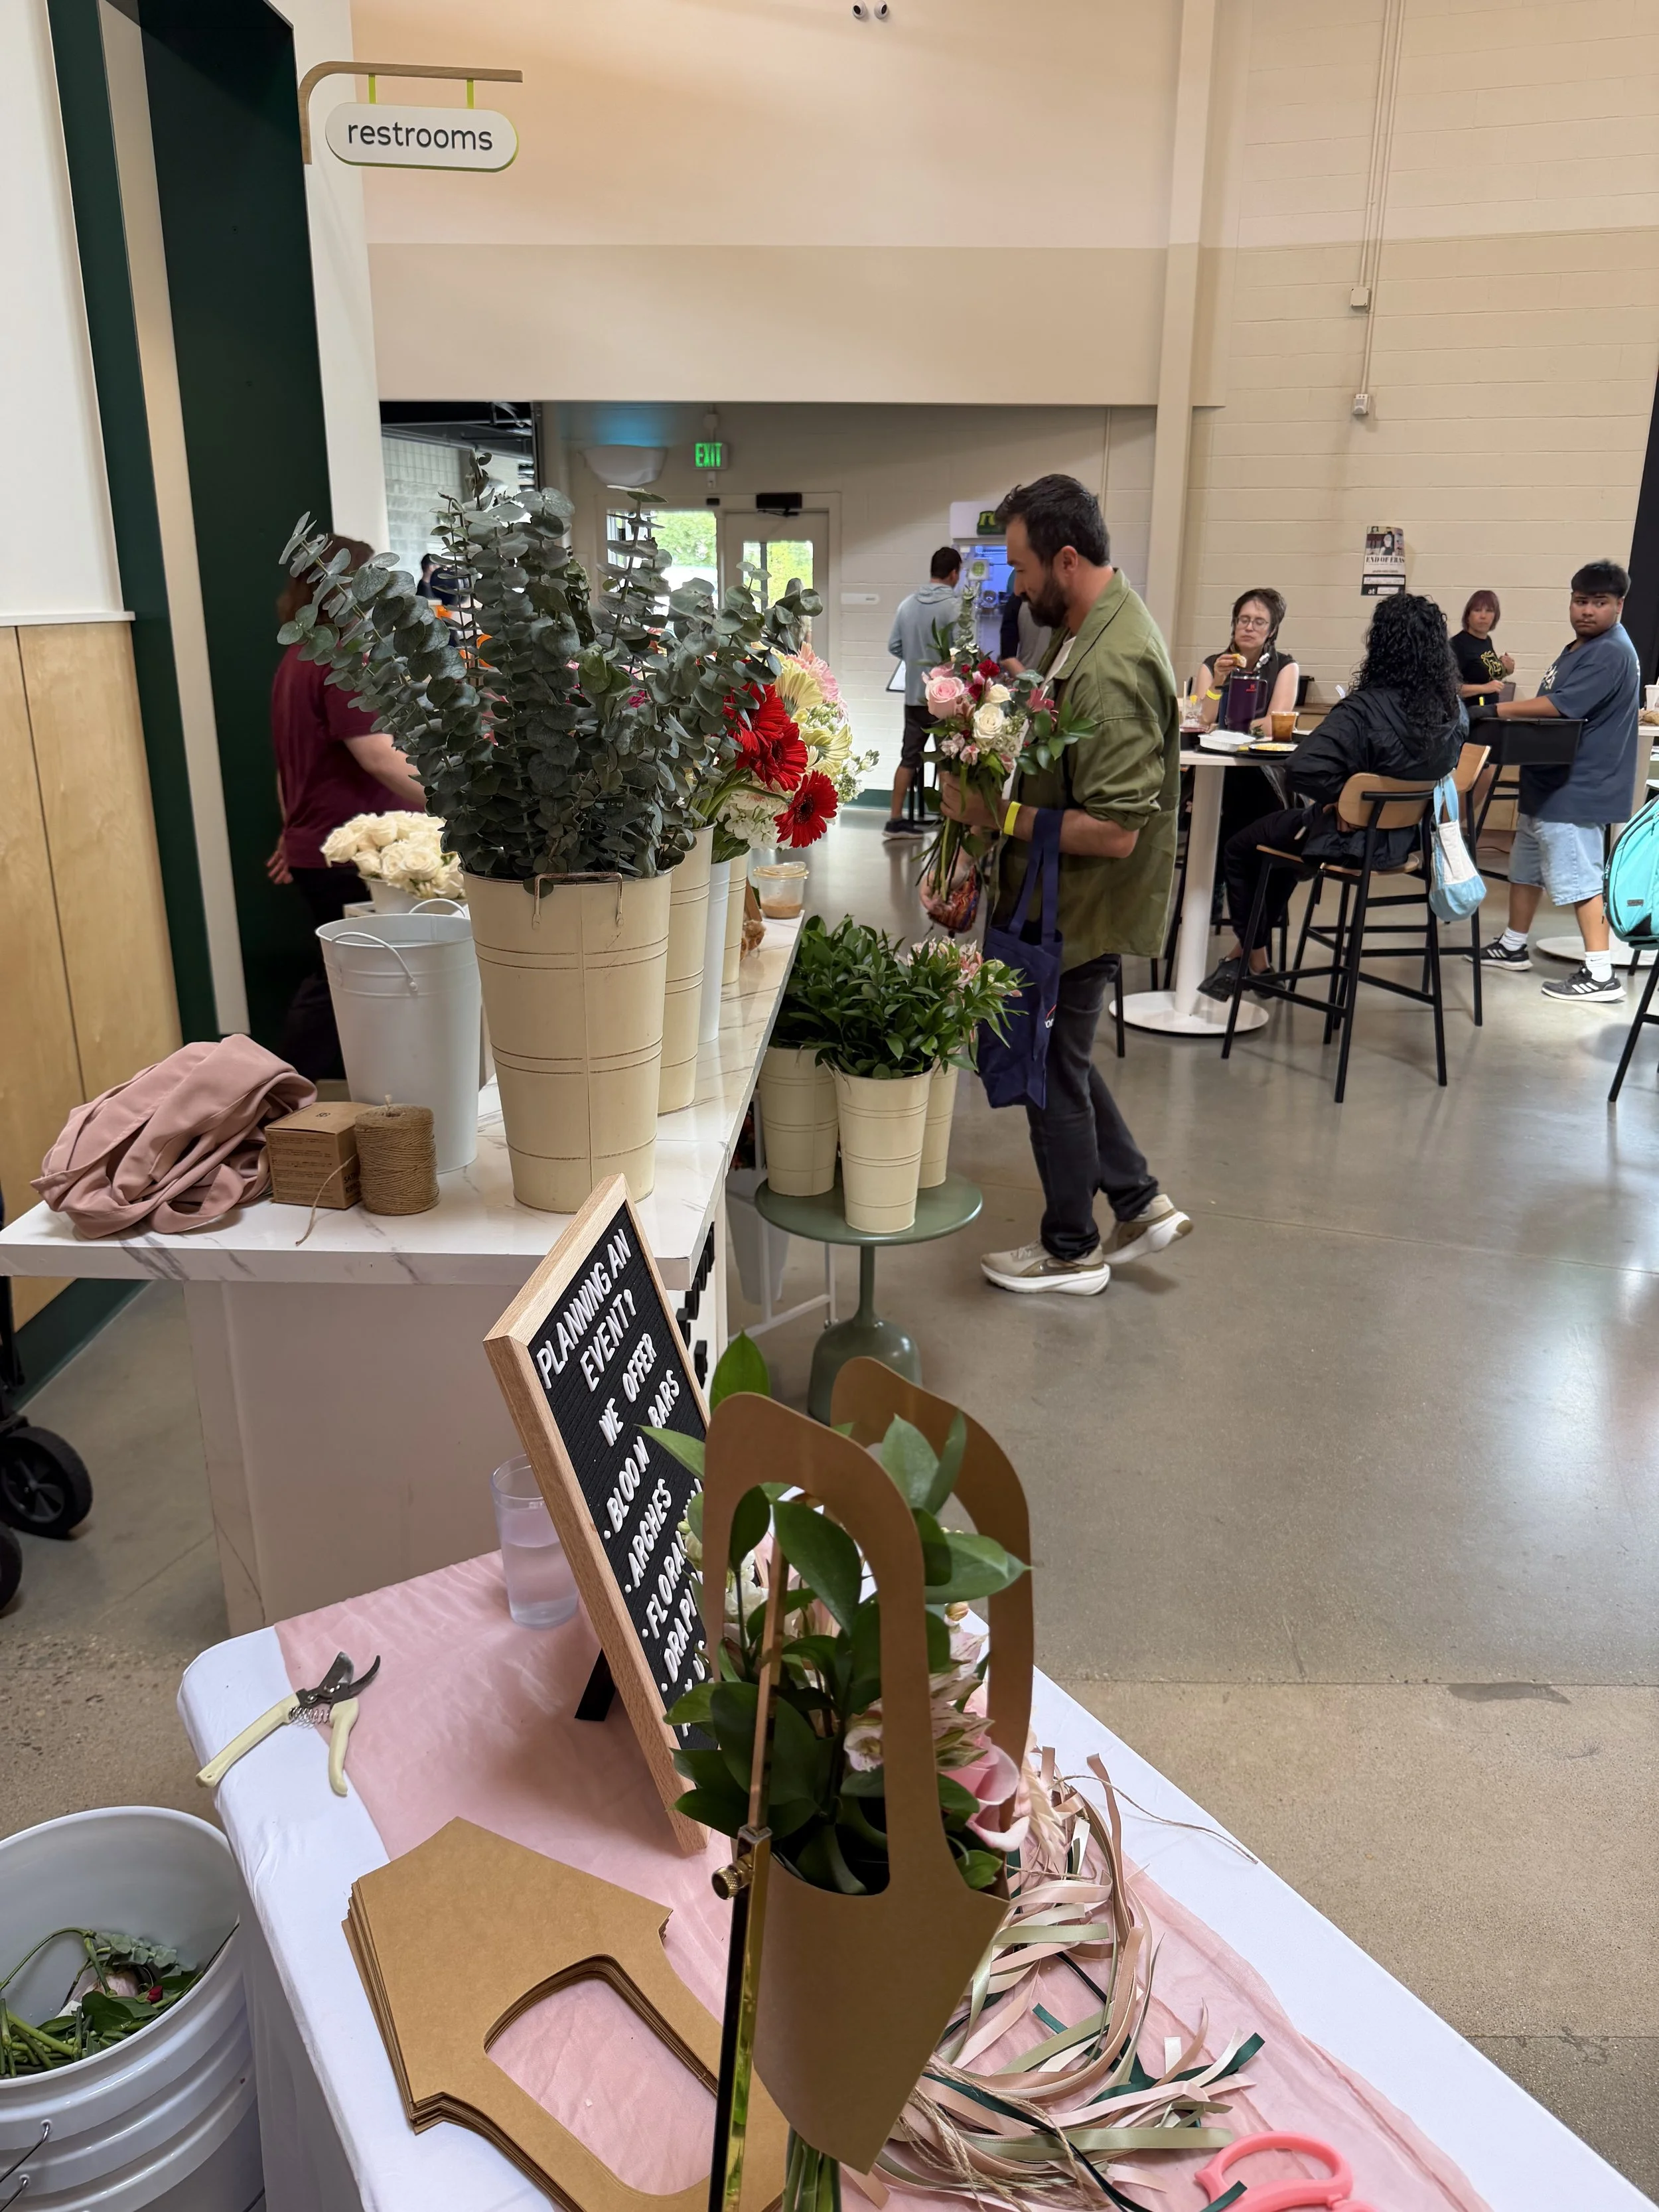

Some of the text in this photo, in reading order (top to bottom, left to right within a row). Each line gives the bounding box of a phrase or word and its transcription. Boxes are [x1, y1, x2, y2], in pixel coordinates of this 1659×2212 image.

[348, 122, 492, 151] restrooms
[695, 443, 722, 467] EXIT
[536, 1228, 631, 1389] PLANNING AN
[580, 1289, 636, 1392] EVENT?
[599, 1333, 658, 1447] WE OFFER
[648, 1370, 680, 1428] BARS
